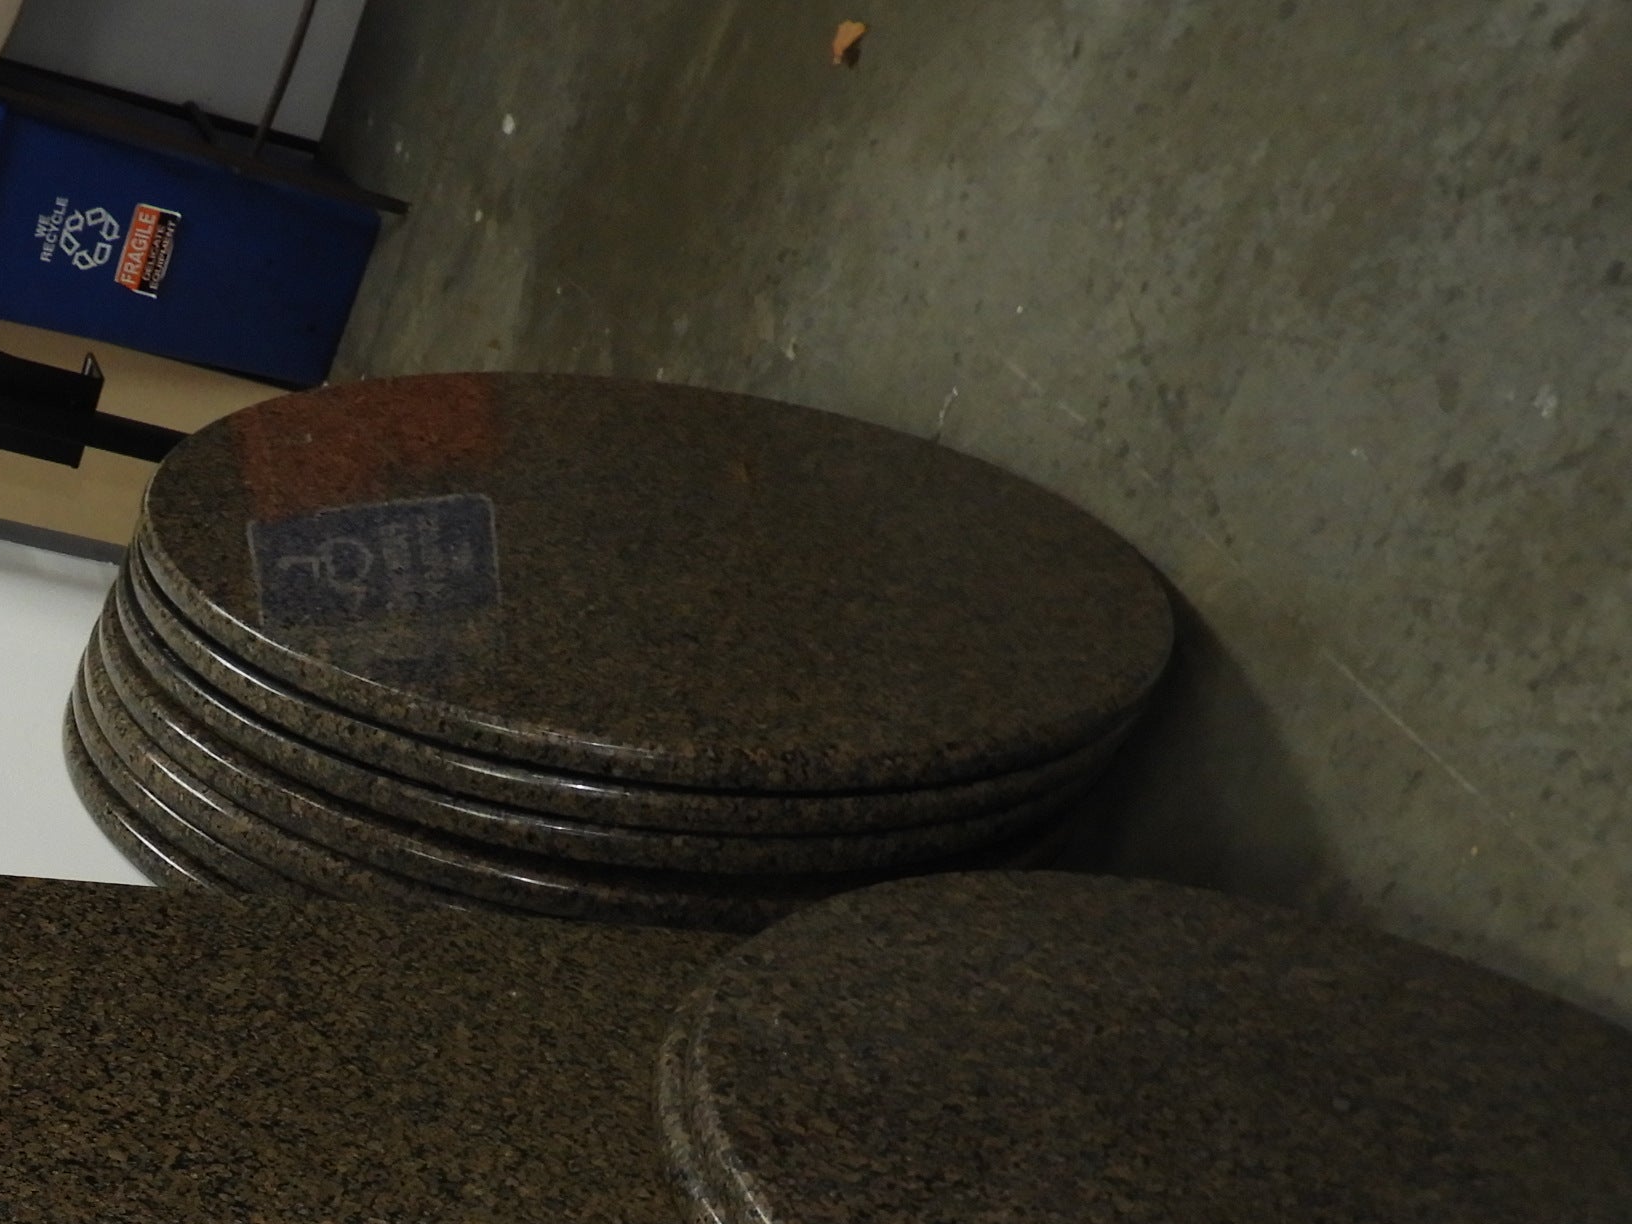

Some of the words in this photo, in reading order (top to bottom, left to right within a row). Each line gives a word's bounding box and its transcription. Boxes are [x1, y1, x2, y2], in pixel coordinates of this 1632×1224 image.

[34, 213, 51, 238] WE
[40, 196, 69, 262] RECYCLE
[121, 210, 156, 284] FRAGILE
[142, 222, 165, 281] DELICATE
[149, 218, 177, 290] EQUIPMENT
